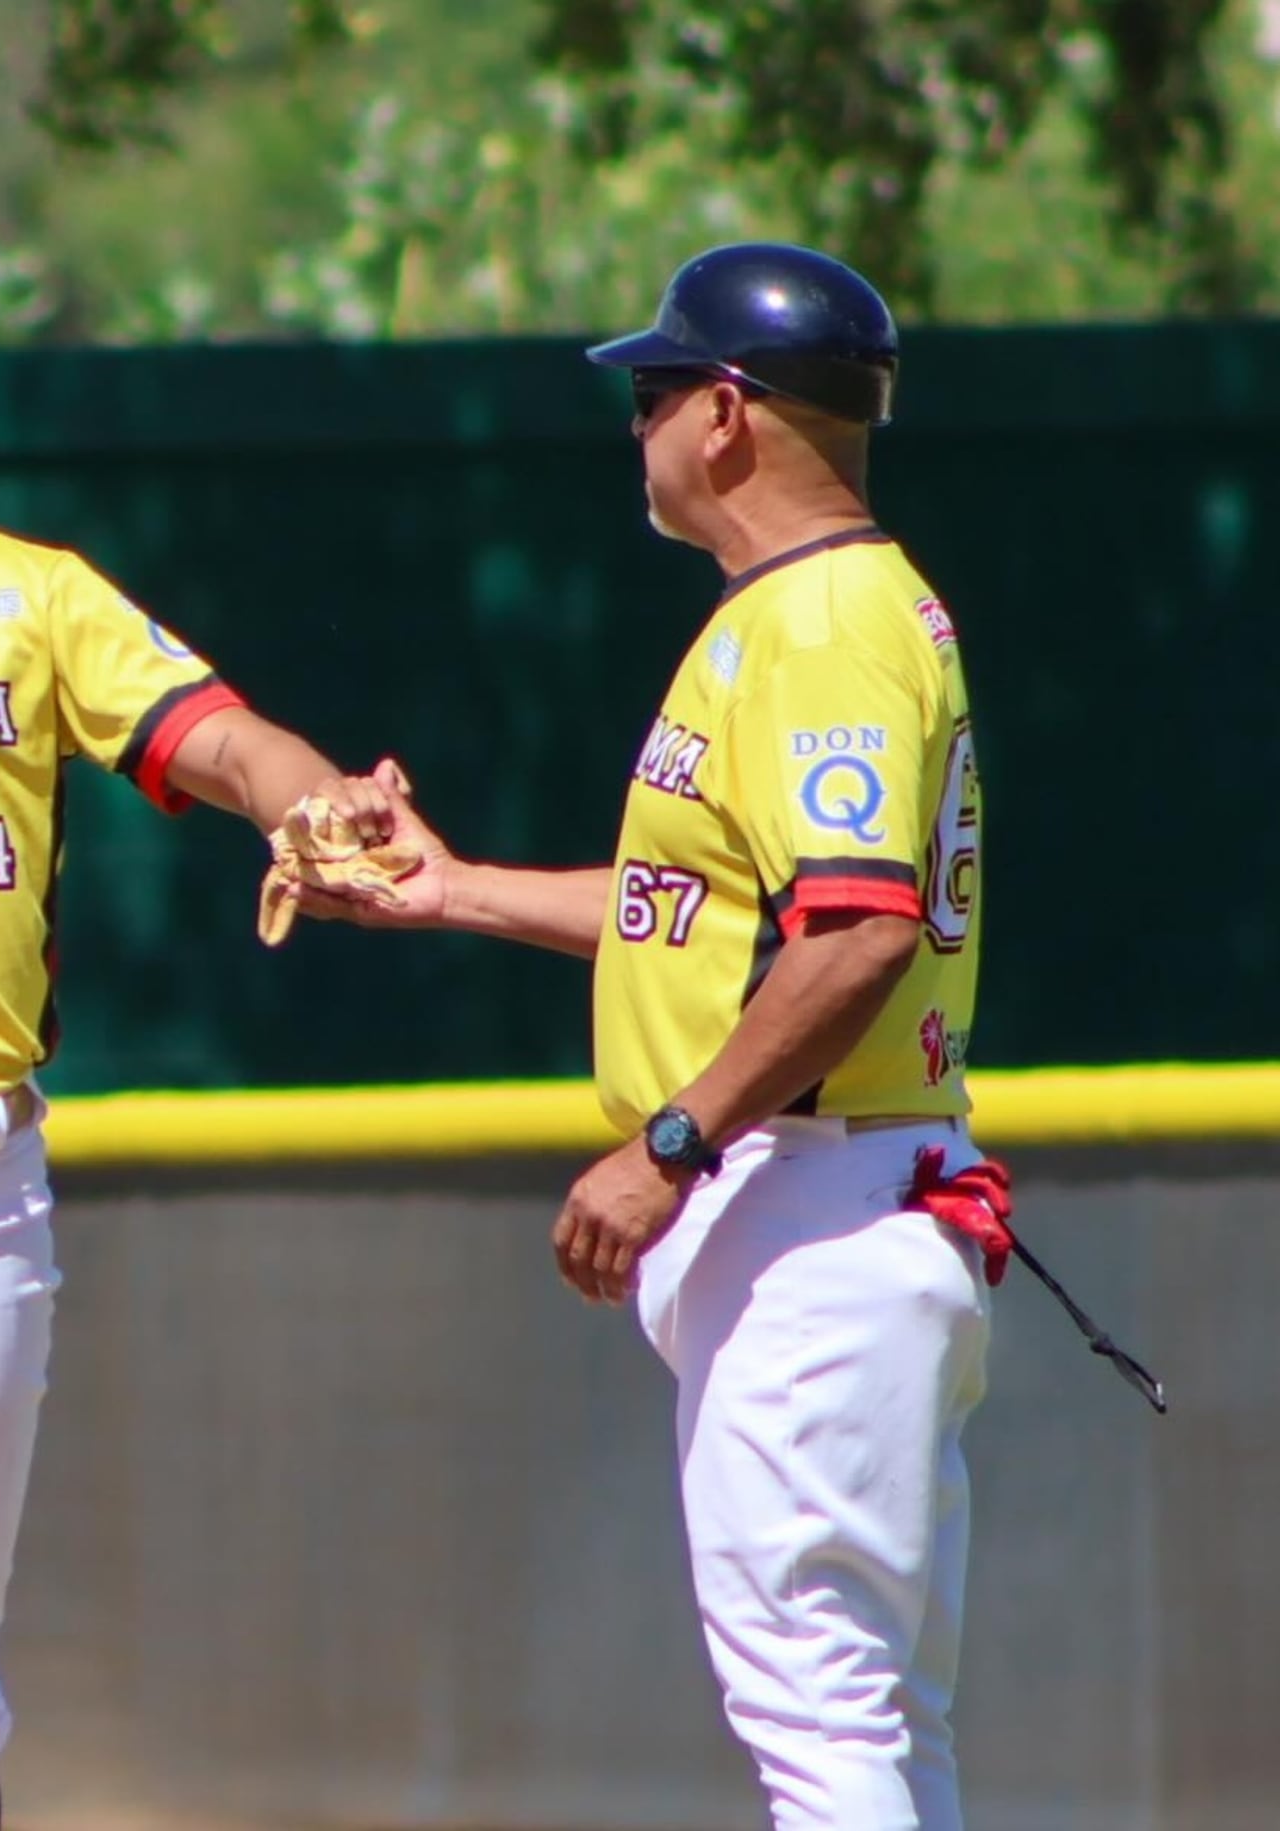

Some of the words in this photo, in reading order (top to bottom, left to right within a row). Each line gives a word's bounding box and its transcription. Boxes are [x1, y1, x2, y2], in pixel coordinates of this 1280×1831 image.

[792, 726, 885, 756] DON
[799, 755, 887, 844] Q
[617, 858, 708, 947] 67
